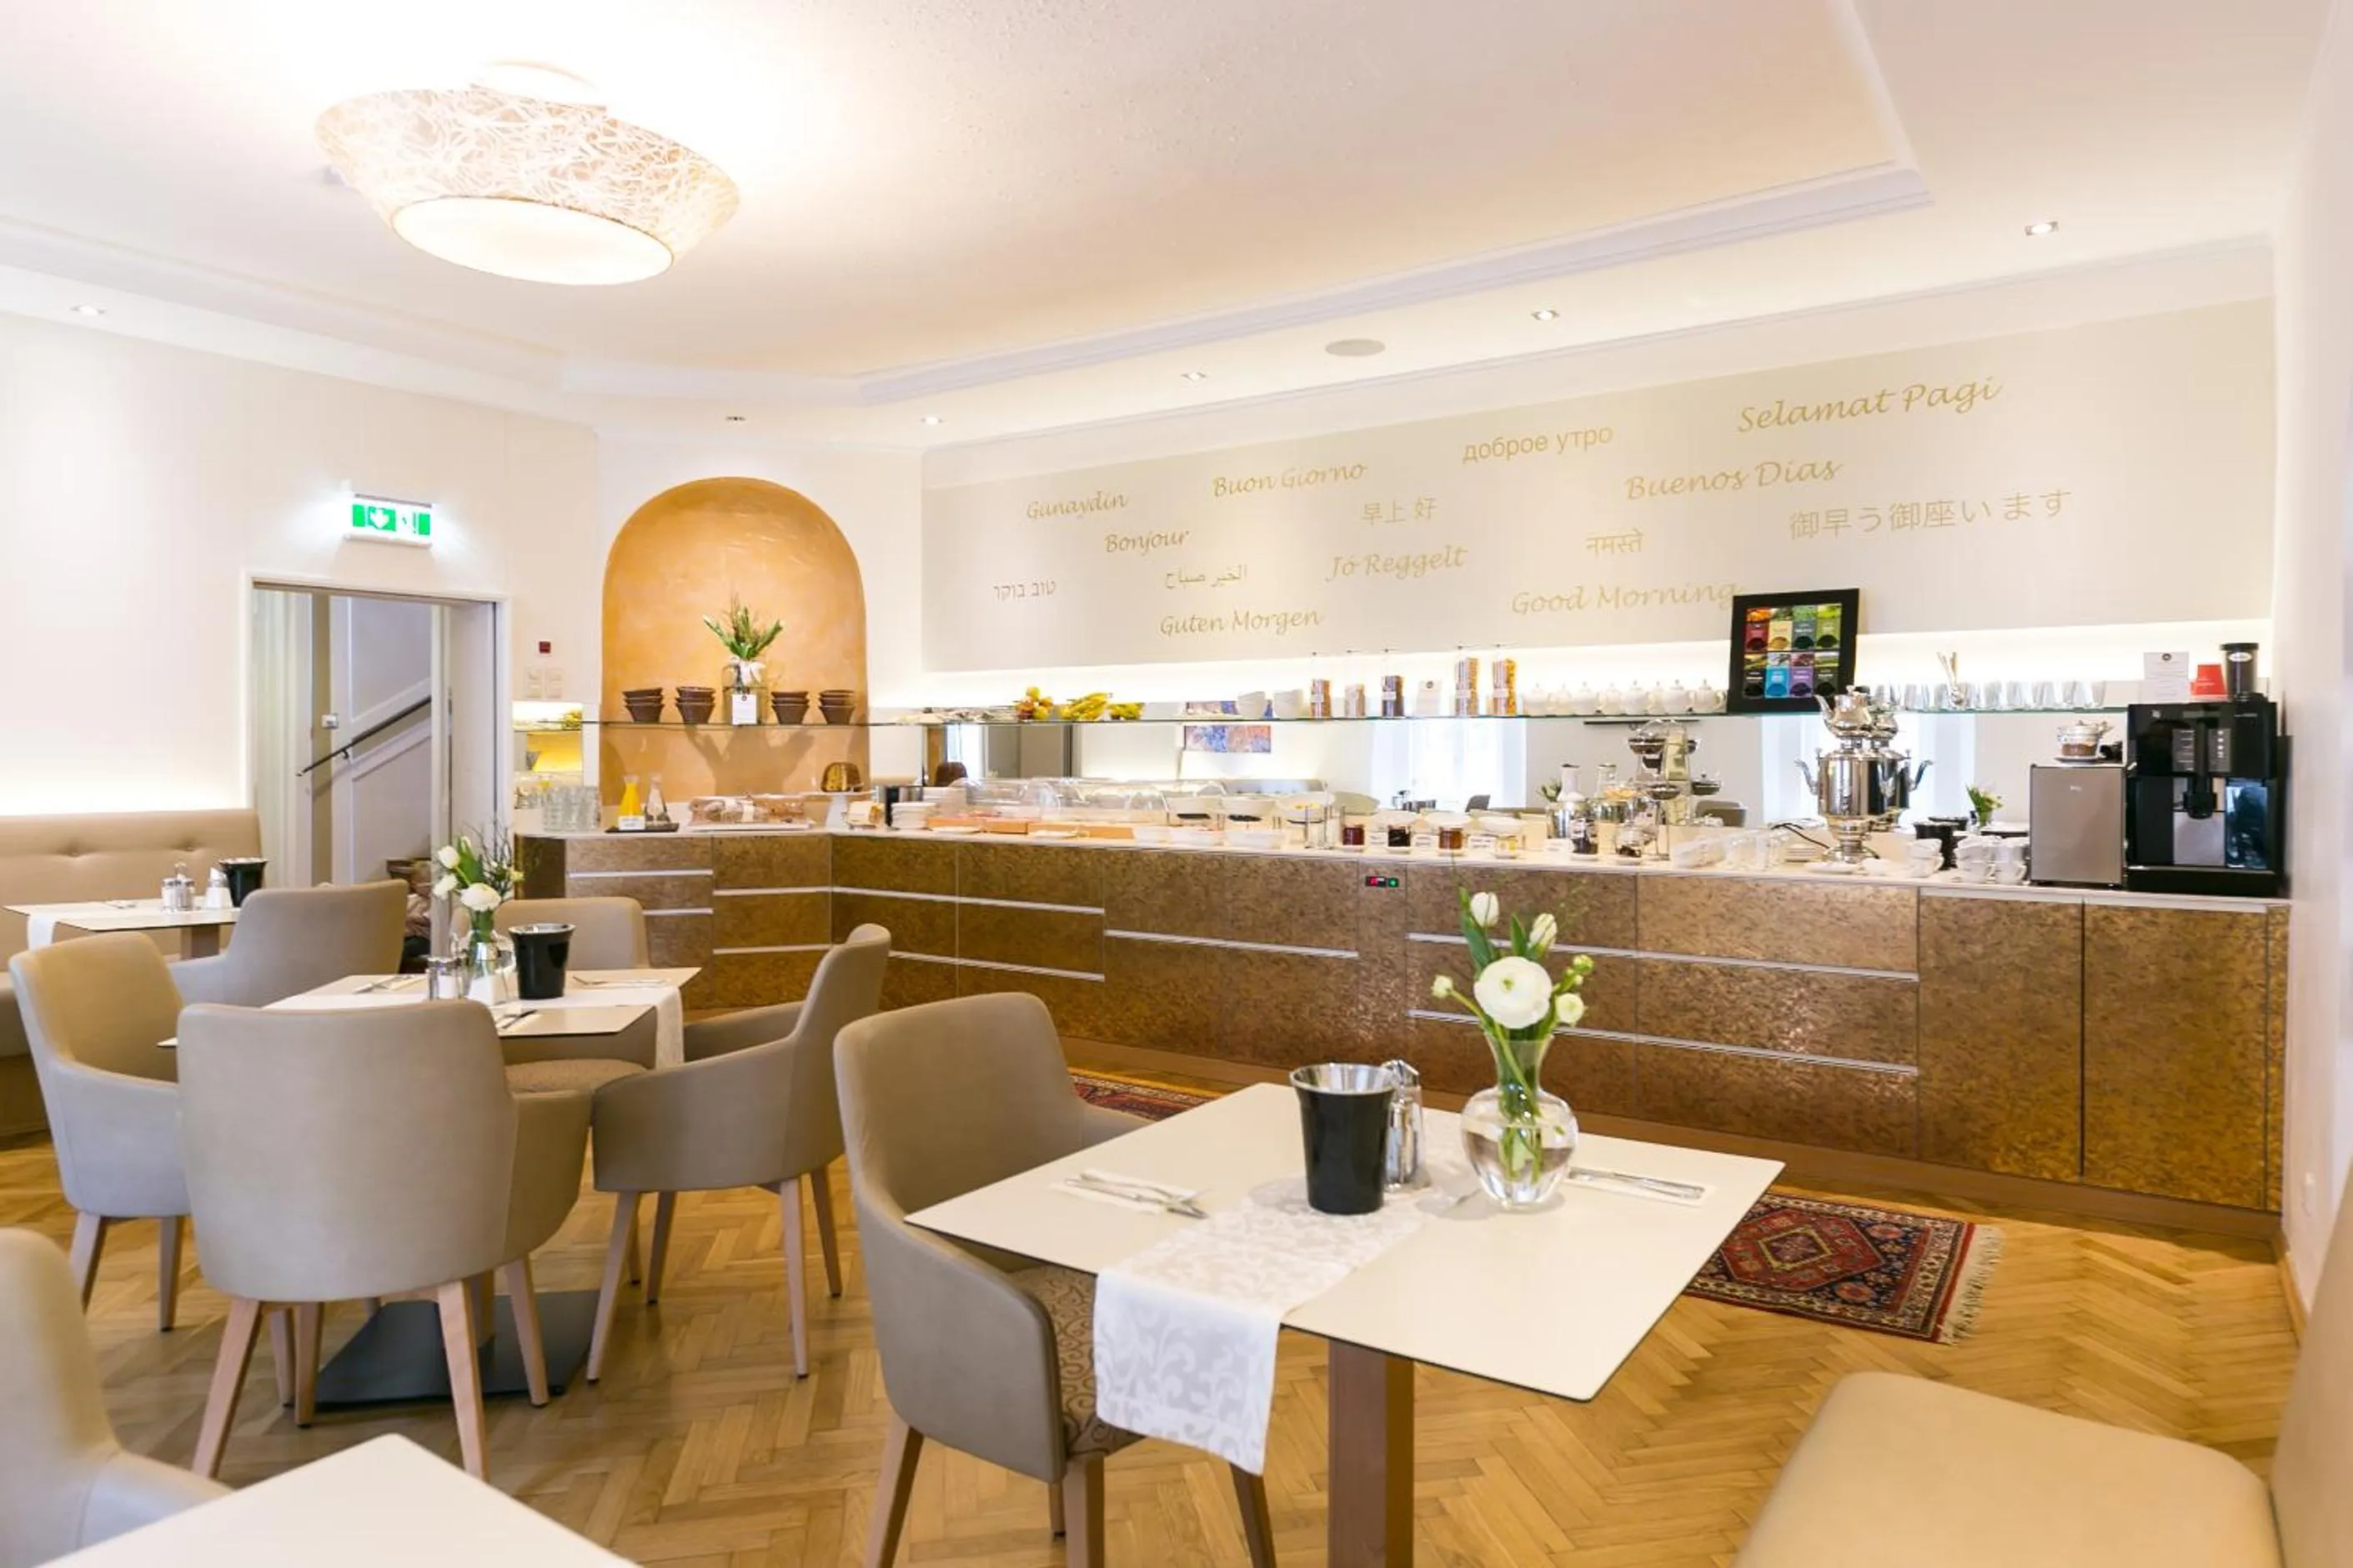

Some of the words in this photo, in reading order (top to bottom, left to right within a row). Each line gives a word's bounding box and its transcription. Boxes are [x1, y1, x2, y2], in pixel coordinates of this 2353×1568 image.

[1737, 388, 1896, 433] Selamat
[1902, 376, 2003, 414] Pagi
[1462, 435, 1548, 464] доброе
[1556, 427, 1613, 454] утро
[1212, 476, 1276, 497] Buon
[1281, 463, 1367, 489] Giorno
[1624, 470, 1749, 500] Buenos
[1104, 530, 1190, 556] Bonjour
[1586, 527, 1644, 554] नमस्ते
[1363, 544, 1468, 579] Reggelt
[1031, 579, 1056, 597] טוב
[1511, 586, 1592, 615] Good
[1596, 583, 1744, 611] Morning
[1160, 614, 1226, 637] Guten
[1232, 609, 1324, 635] Morgen
